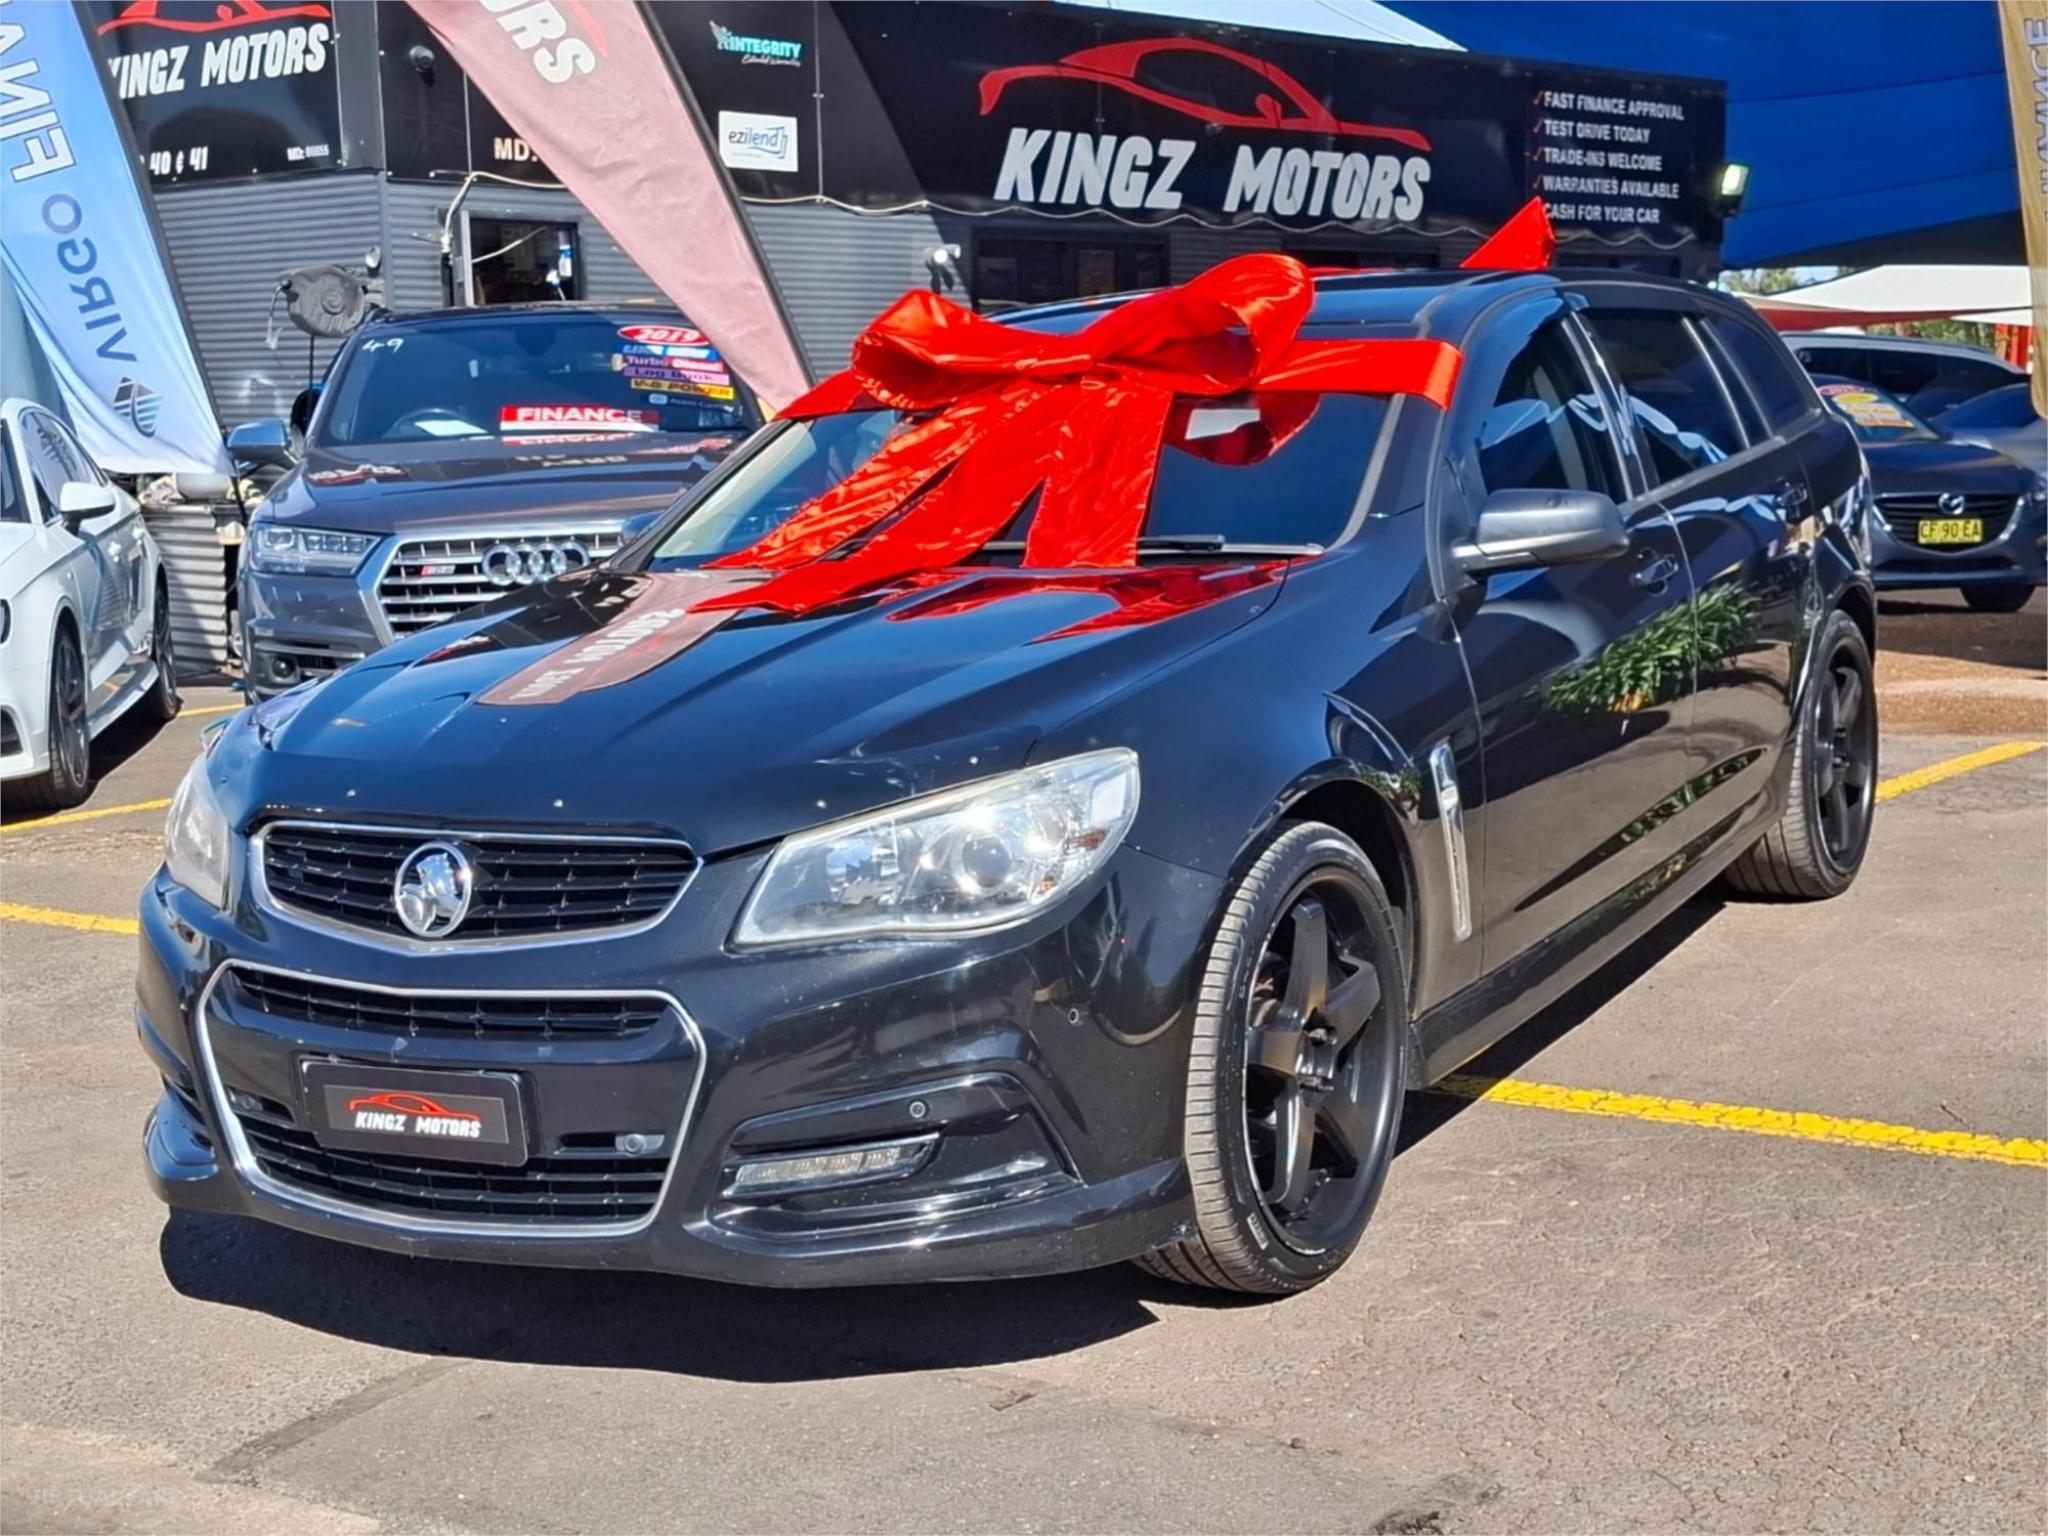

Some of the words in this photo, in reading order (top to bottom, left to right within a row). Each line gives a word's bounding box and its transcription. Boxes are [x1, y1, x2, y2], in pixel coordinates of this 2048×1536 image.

[200, 22, 330, 88] MOTORS
[728, 36, 802, 58] INTEGRITY
[1543, 91, 1575, 109] FAST
[1577, 95, 1626, 115] FINANCE
[1628, 100, 1685, 121] APPROVAL
[728, 127, 780, 147] ezilend
[1544, 119, 1574, 137] TEST
[1576, 122, 1611, 140] DRIVE
[1613, 125, 1650, 144] TODAY
[149, 150, 172, 176] 40
[189, 146, 208, 171] 41
[1544, 147, 1606, 167] TRADE-INS
[1608, 152, 1662, 171] WELCOME
[994, 127, 1196, 211] KINGZ
[1223, 145, 1431, 222] MOTORS
[1543, 176, 1618, 195] WARRANTIES
[1620, 180, 1680, 199] AVAILABLE
[1577, 205, 1602, 221] FOR
[1604, 206, 1635, 223] YOUR
[1636, 207, 1660, 224] CAR
[635, 328, 700, 344] 2019
[516, 406, 642, 424] FINANCE
[1920, 522, 1937, 538] CF
[1942, 521, 1959, 538] 90
[1963, 519, 1980, 537] EA
[354, 1111, 407, 1132] KINGZ
[415, 1115, 482, 1138] MOTORS
